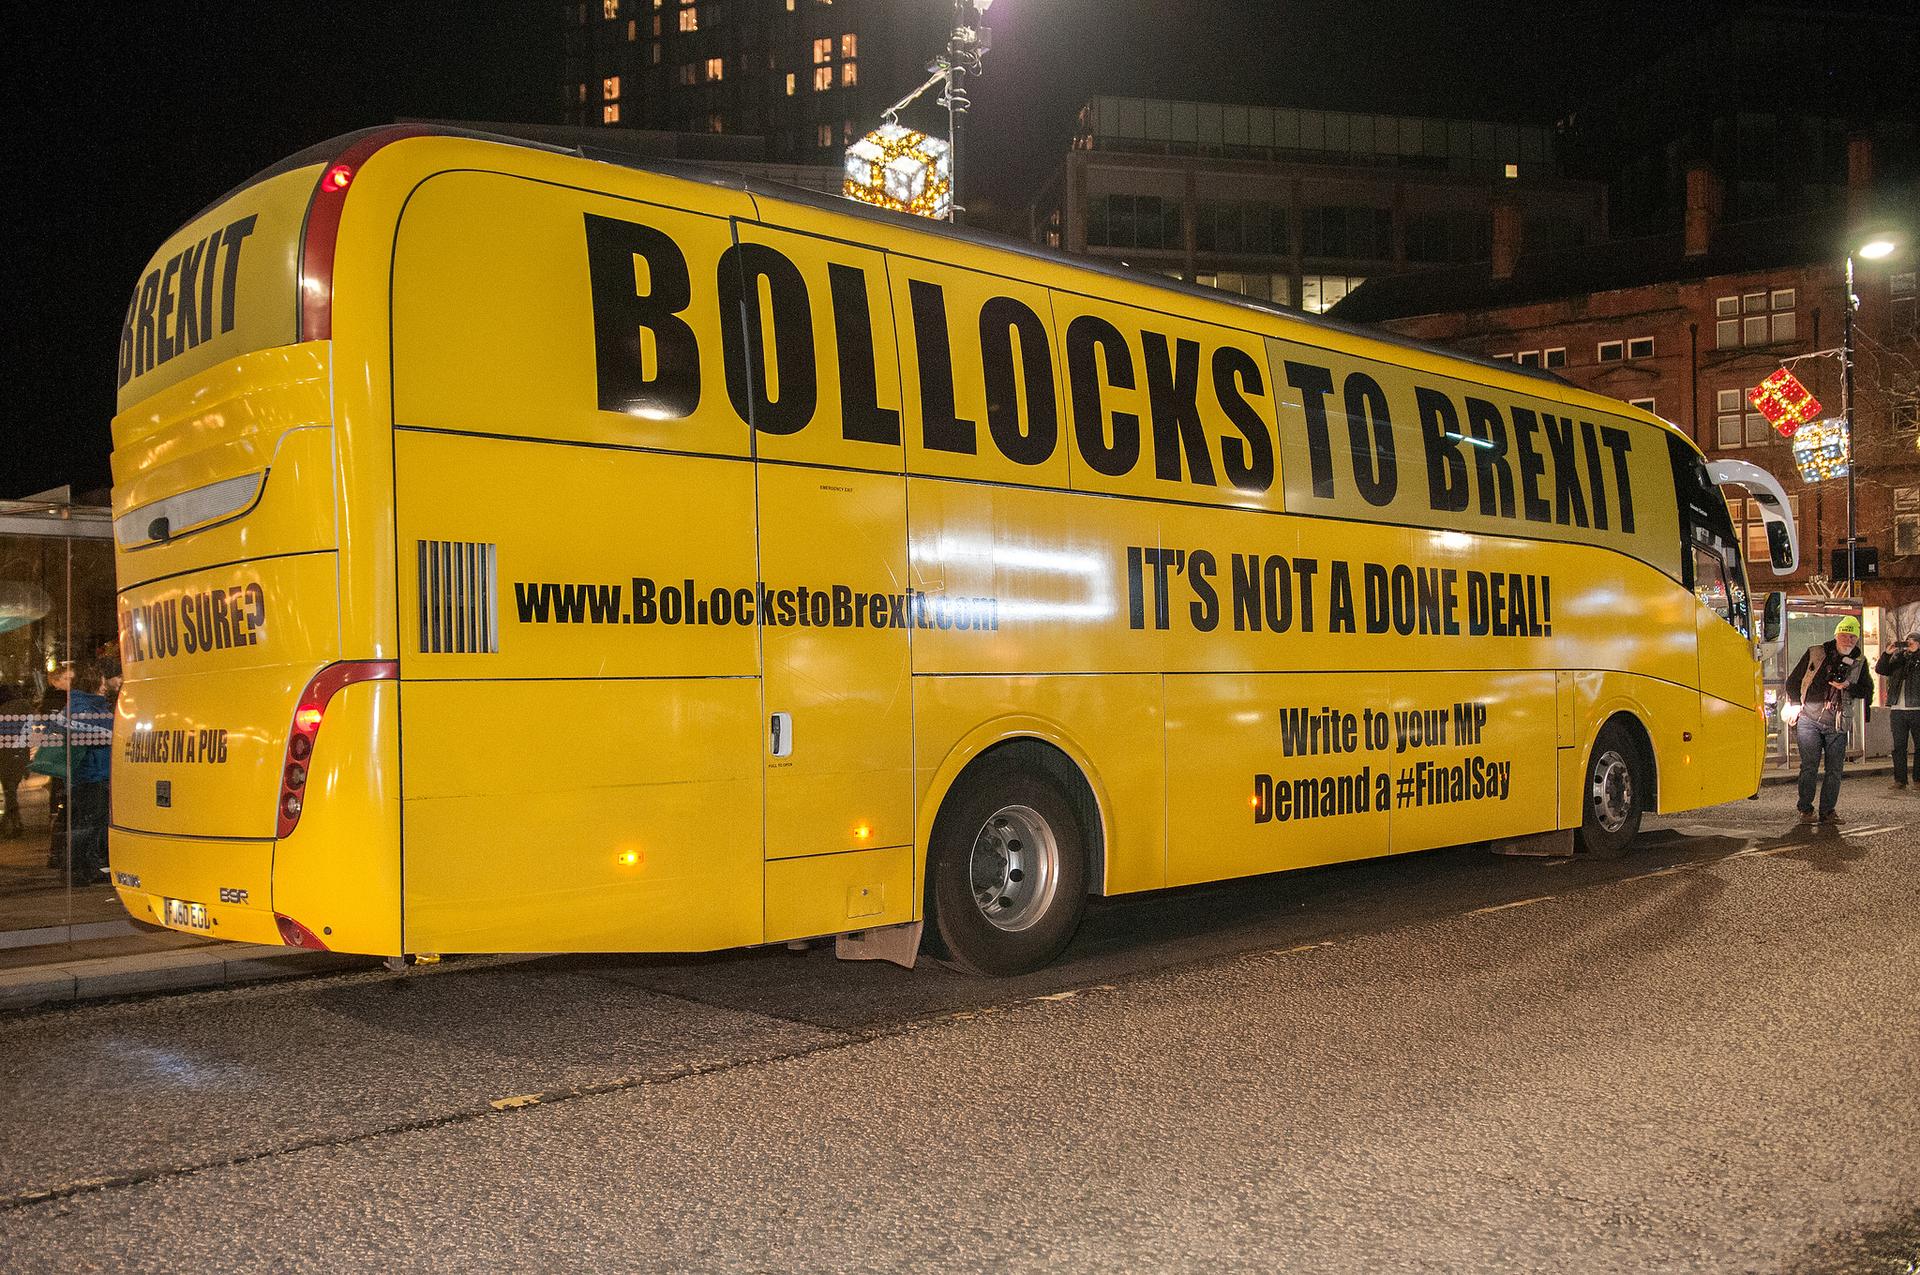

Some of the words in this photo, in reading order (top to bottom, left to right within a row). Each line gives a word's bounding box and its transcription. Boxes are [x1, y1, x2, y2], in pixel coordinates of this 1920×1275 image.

[118, 213, 259, 391] BREXIT
[583, 211, 1275, 499] BOLLOCKS
[1284, 360, 1398, 507] TO
[1414, 386, 1635, 534] BREXIT
[143, 598, 178, 660] YOU
[181, 582, 265, 655] SURE?
[1127, 546, 1219, 632] IT'S
[1231, 553, 1318, 632] NOT
[1329, 561, 1356, 633] A
[1364, 563, 1460, 636] DONE
[1467, 570, 1552, 637] DEAL!
[171, 730, 186, 763] IN
[186, 730, 195, 763] A
[198, 729, 228, 764] PUB
[1279, 706, 1358, 758] Write
[1364, 708, 1389, 751] to
[1394, 709, 1449, 754] your
[1453, 702, 1487, 746] MP
[1254, 766, 1370, 825] Demand
[1375, 773, 1391, 812] a
[1396, 756, 1511, 808] #FinalSay
